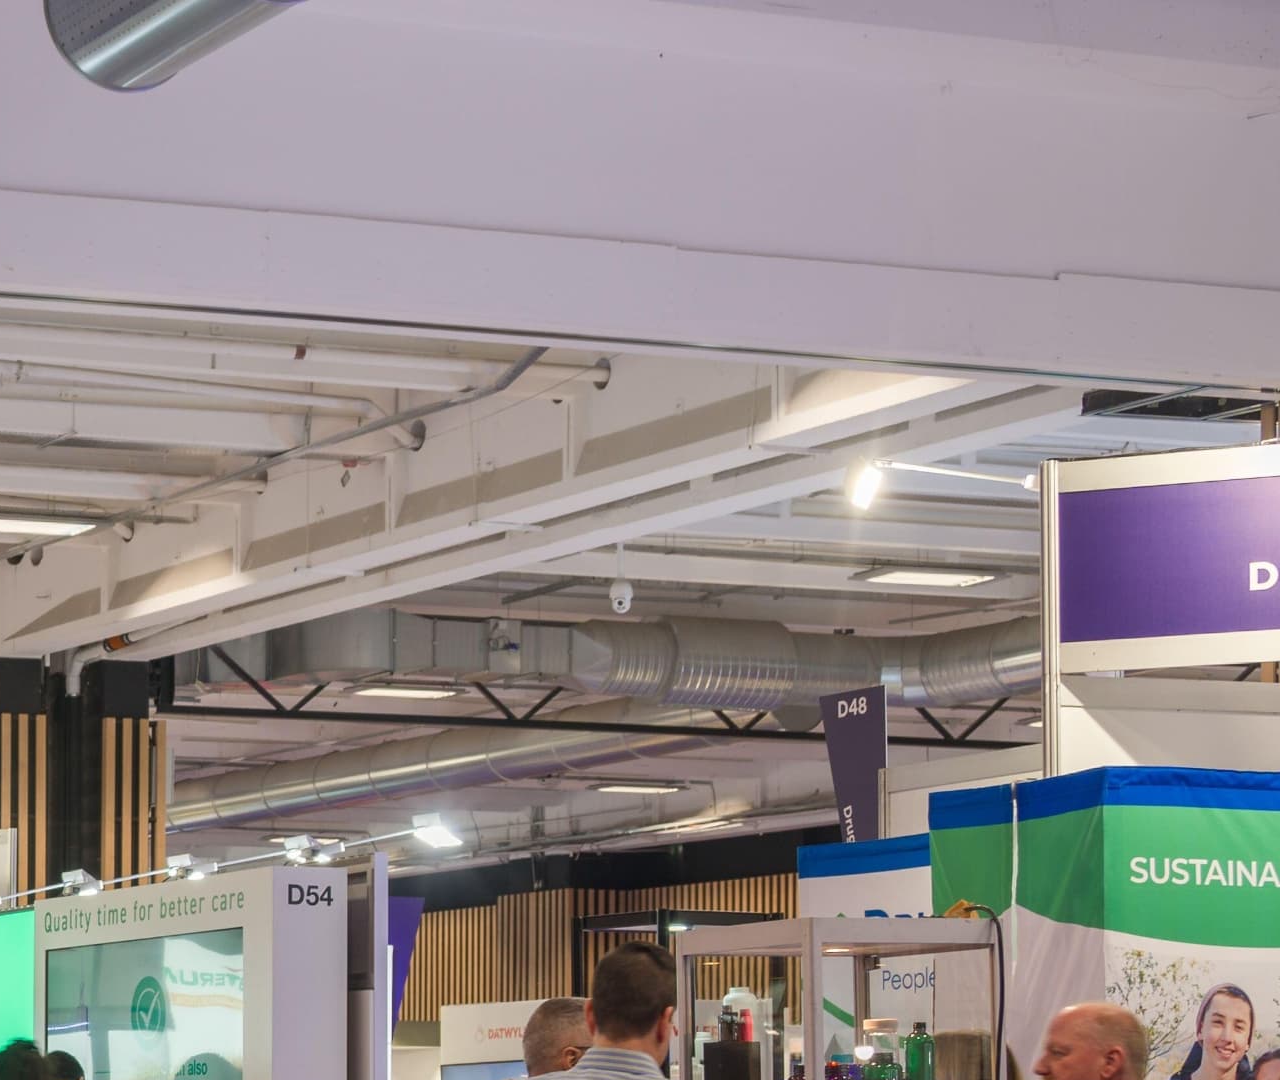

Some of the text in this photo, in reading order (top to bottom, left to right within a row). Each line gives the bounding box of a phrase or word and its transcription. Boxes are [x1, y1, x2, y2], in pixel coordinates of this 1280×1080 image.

[837, 696, 868, 719] D48
[1129, 856, 1280, 887] SUSTAINA
[287, 883, 334, 907] D54
[44, 890, 244, 933] Quality time for better care
[882, 966, 936, 994] People
[187, 1059, 208, 1076] also
